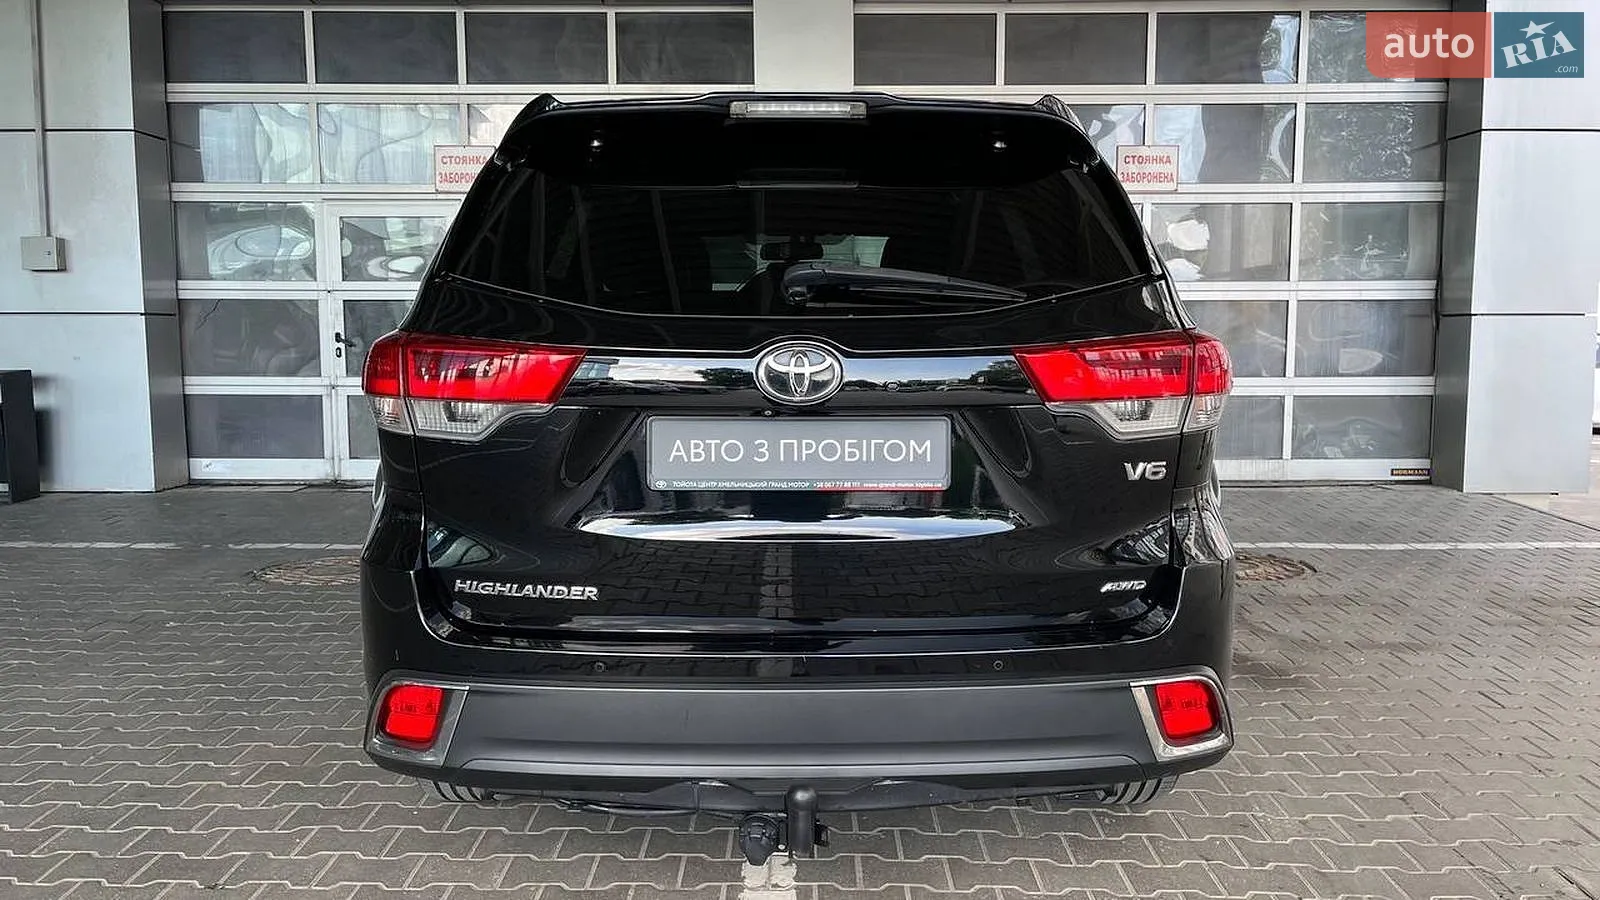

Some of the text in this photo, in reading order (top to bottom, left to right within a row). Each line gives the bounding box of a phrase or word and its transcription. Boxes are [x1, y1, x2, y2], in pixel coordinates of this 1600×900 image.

[1124, 155, 1172, 165] СТОЯНКА
[1120, 171, 1175, 184] ЗАБОРОНЕНА
[669, 440, 744, 462] АВТО
[779, 439, 932, 462] ПРОБІГОМ
[1123, 461, 1167, 481] V6
[454, 579, 599, 601] HIGHLANDER
